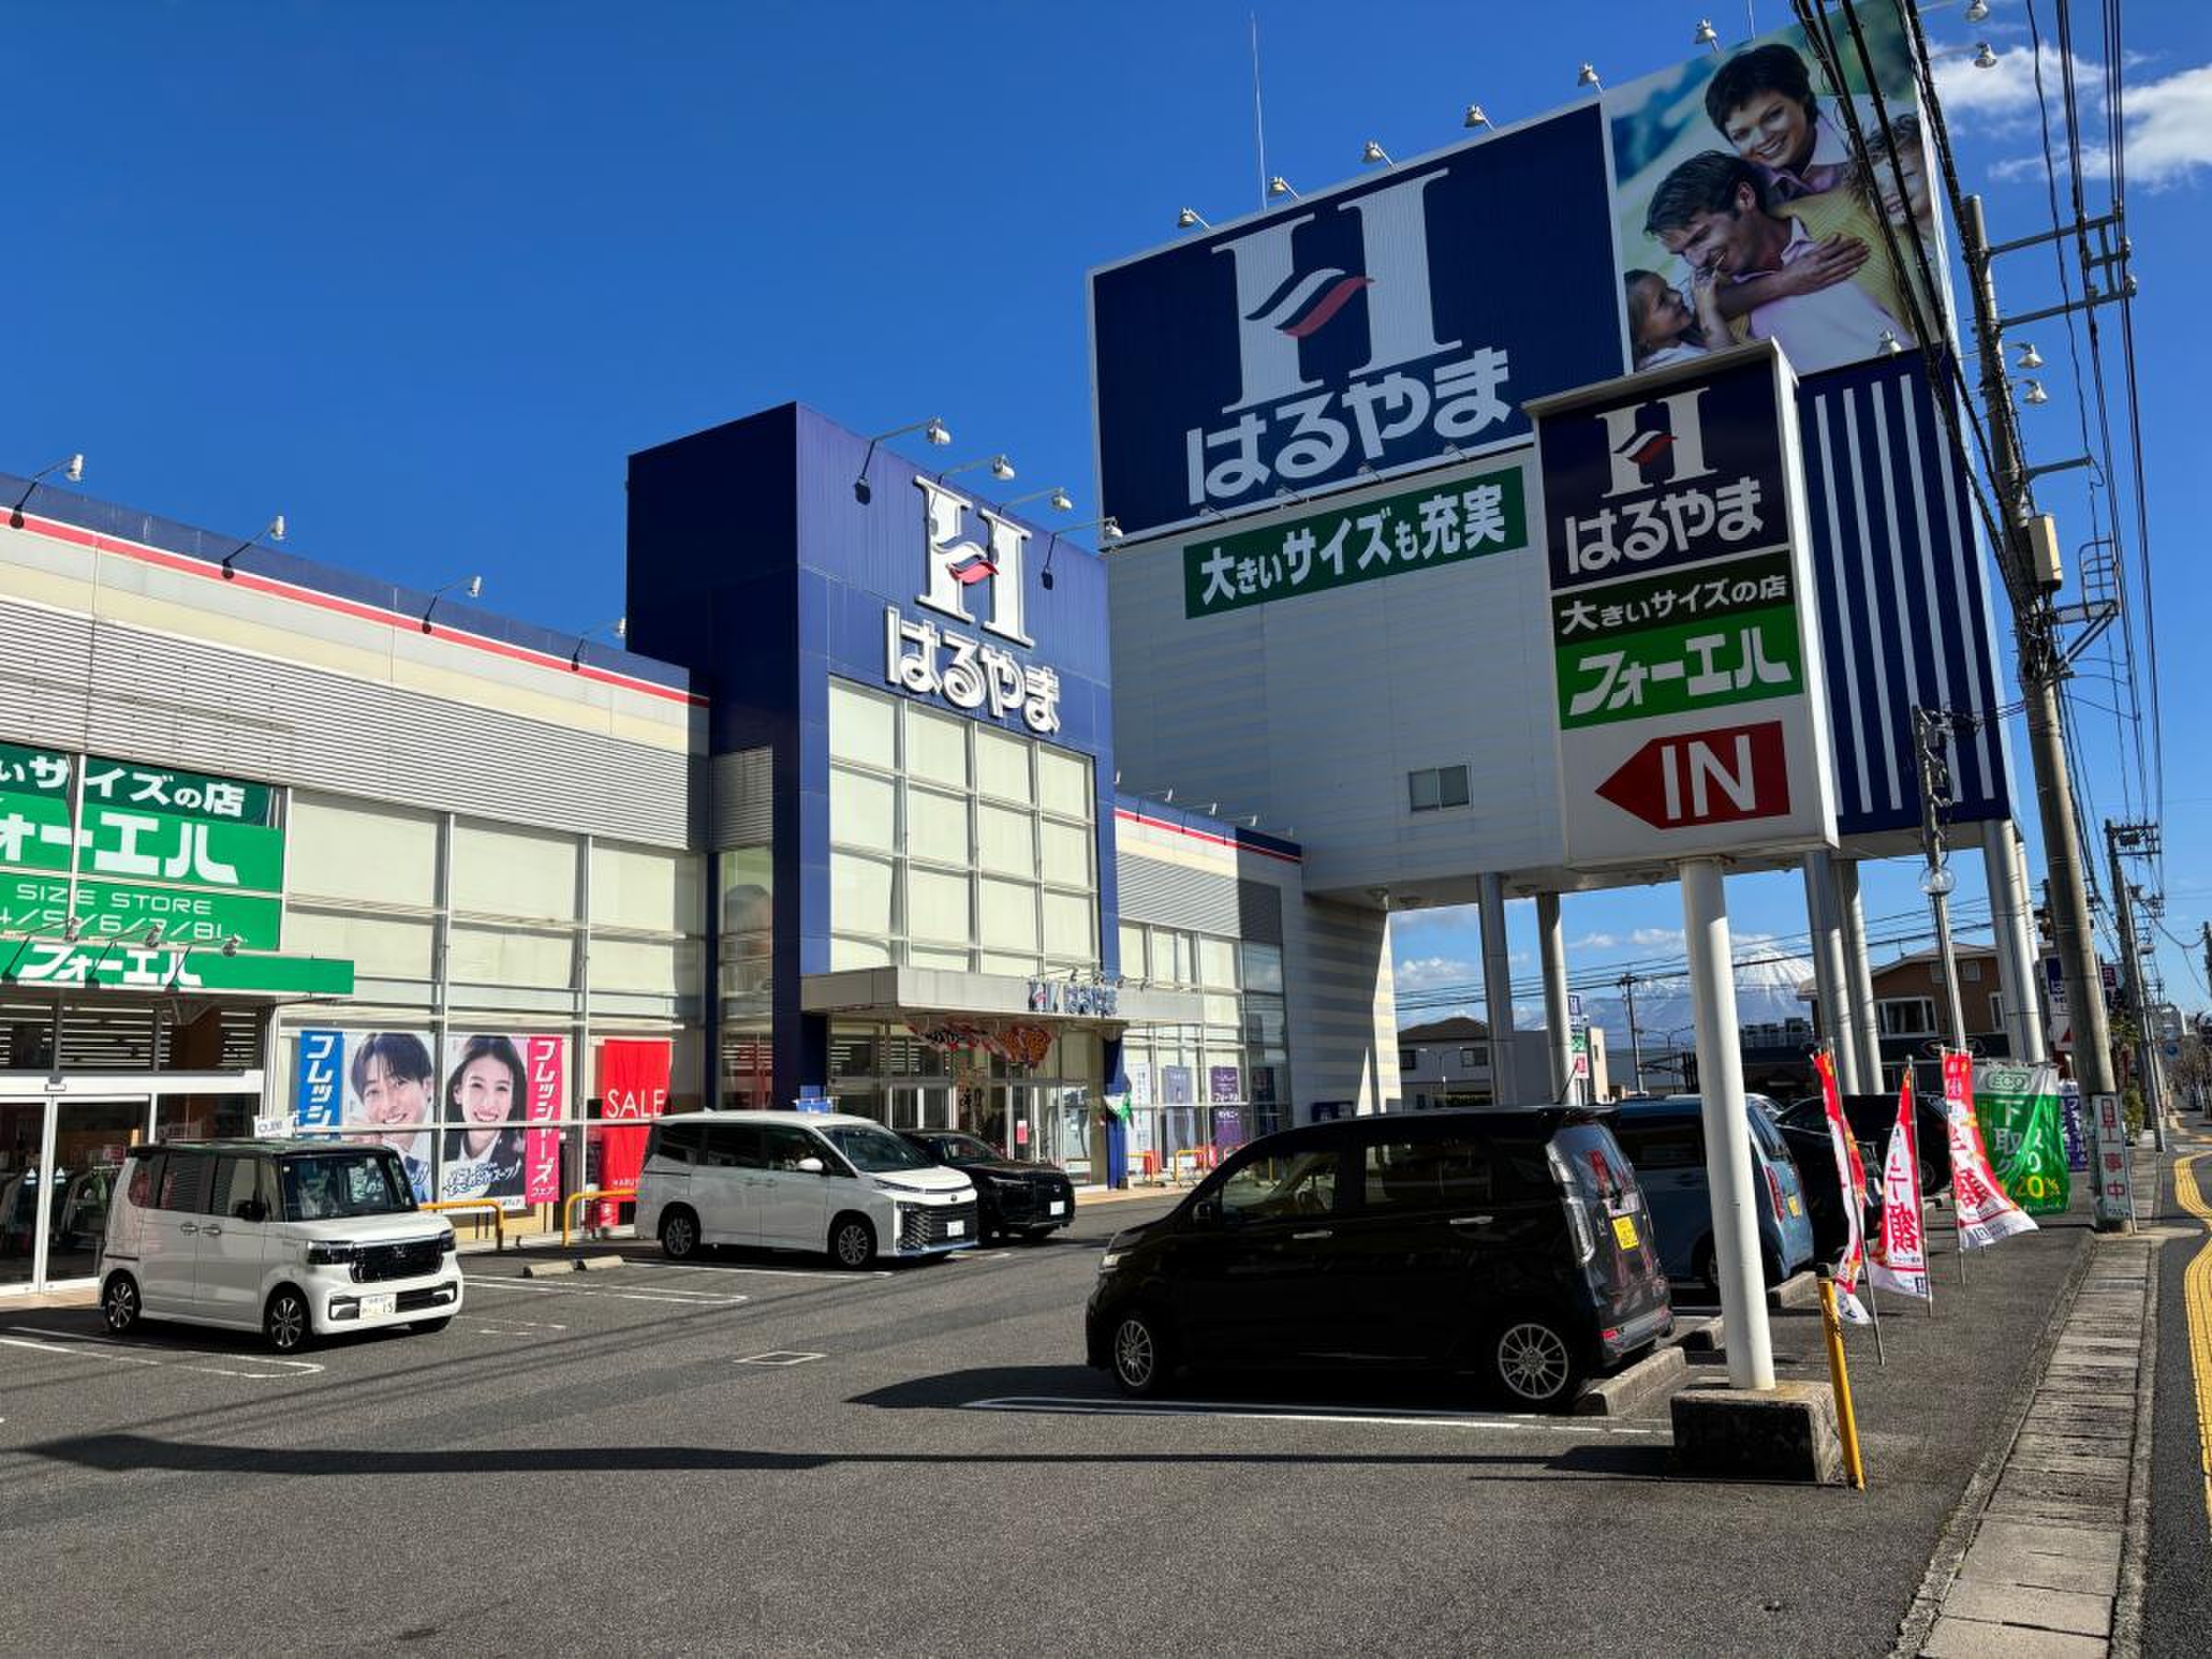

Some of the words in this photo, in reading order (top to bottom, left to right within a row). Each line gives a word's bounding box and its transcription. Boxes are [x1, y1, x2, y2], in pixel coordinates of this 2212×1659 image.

[1186, 345, 1512, 505] はるやま
[1200, 483, 1506, 606] 大きいサイズも充実
[1564, 476, 1765, 575] はるやま
[1560, 574, 1789, 637] 大きいサイズの店
[885, 605, 1061, 735] はるやま
[1569, 627, 1793, 716] フォーエル
[1660, 734, 1756, 820] IN
[0, 798, 239, 885] ォーエル
[17, 883, 96, 906] SIZE
[110, 891, 212, 915] STORE
[18, 943, 203, 986] フォーエル
[606, 1088, 665, 1118] SALE
